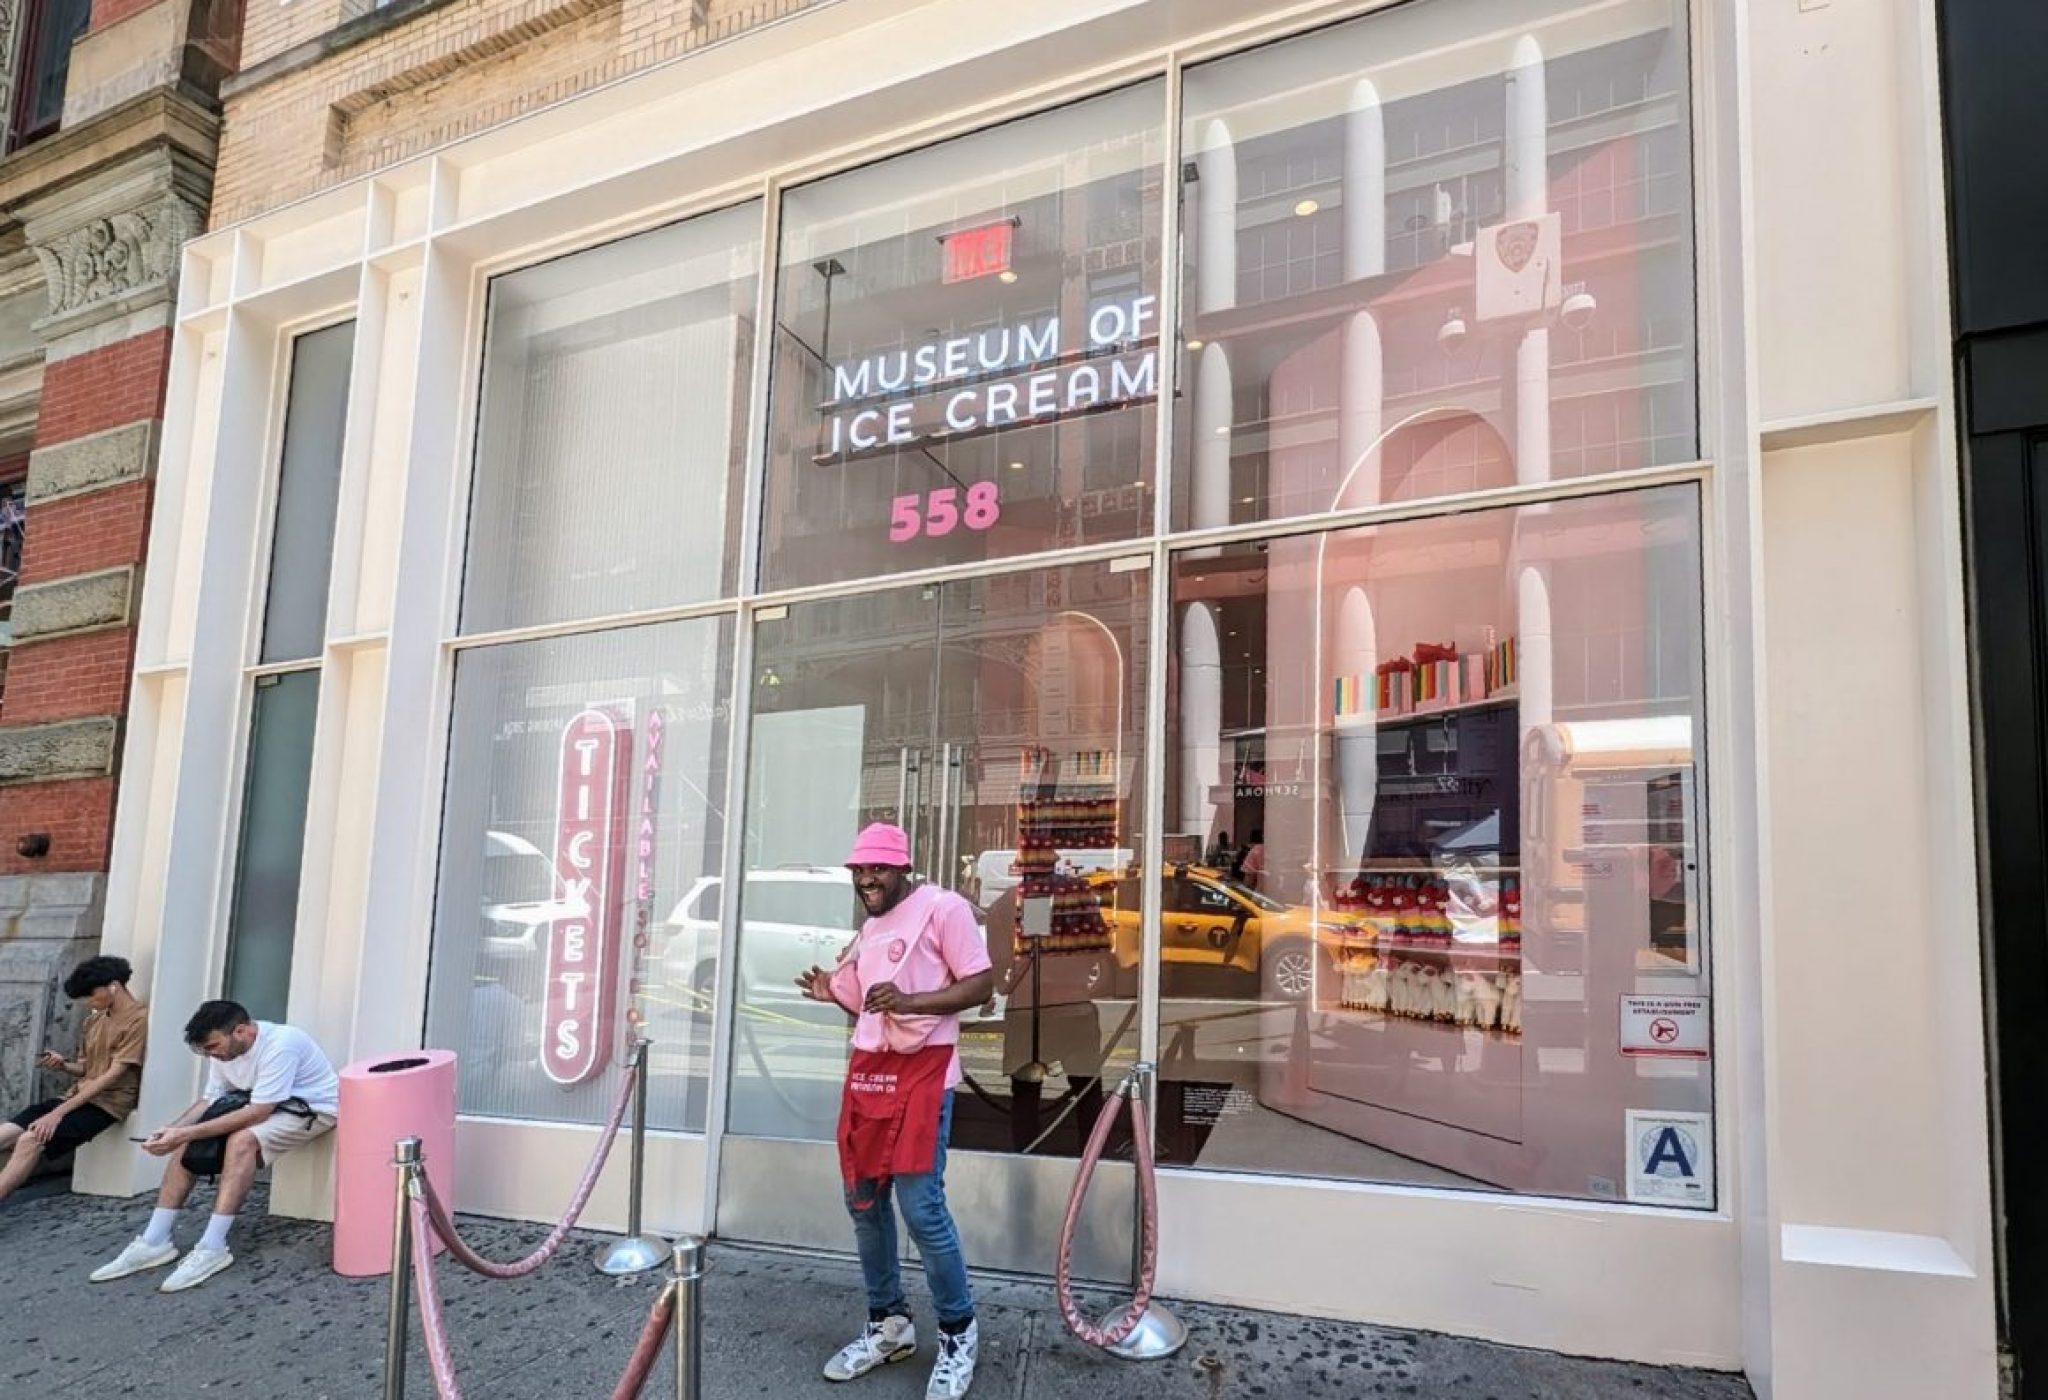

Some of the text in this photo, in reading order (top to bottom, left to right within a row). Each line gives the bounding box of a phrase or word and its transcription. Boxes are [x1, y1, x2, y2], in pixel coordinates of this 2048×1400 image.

[834, 296, 1156, 401] MUSEUM OF
[830, 353, 1157, 454] ICE CREAM
[889, 482, 1000, 543] 558
[638, 710, 663, 899] AVAILABLE
[555, 738, 599, 1061] TICKETS
[1643, 1127, 1695, 1177] A
